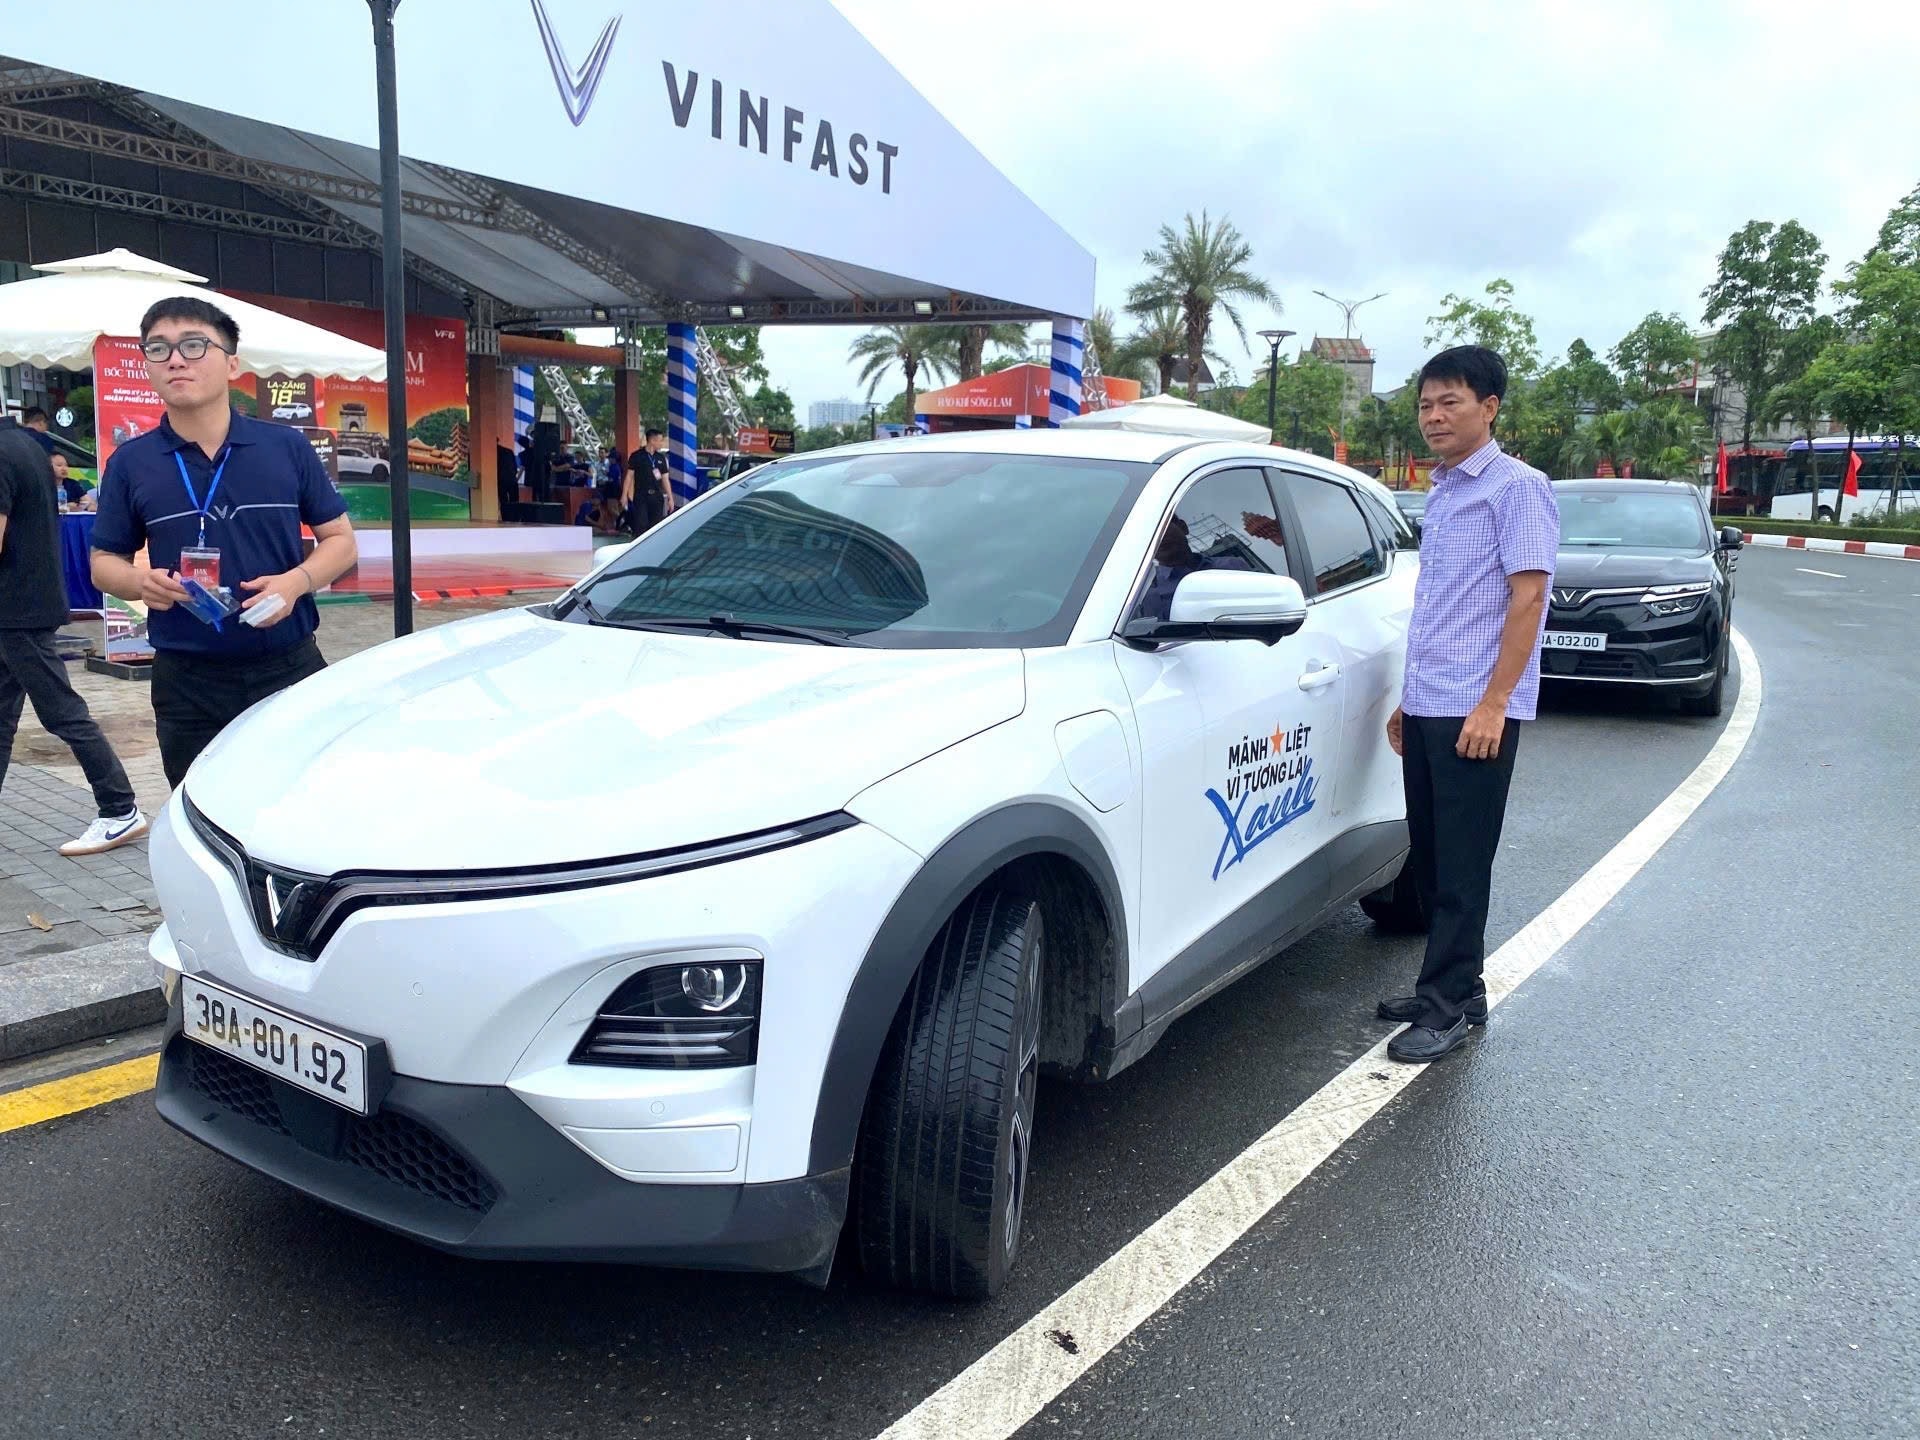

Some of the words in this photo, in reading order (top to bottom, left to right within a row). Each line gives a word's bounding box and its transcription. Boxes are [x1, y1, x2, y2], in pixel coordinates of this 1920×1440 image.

[661, 60, 899, 194] VINFAST
[115, 342, 140, 350] VINFAS
[405, 351, 424, 373] M
[267, 380, 306, 390] LA-ZĂNG
[270, 388, 293, 406] 18
[1542, 635, 1599, 647] A-032.00
[1228, 735, 1268, 769] MÃNH
[1286, 722, 1311, 756] LIỆT
[1227, 769, 1241, 801] VÌ
[1244, 762, 1287, 793] TƯƠNG
[1205, 758, 1316, 881] Xanh
[196, 993, 347, 1094] 38A-801.92
